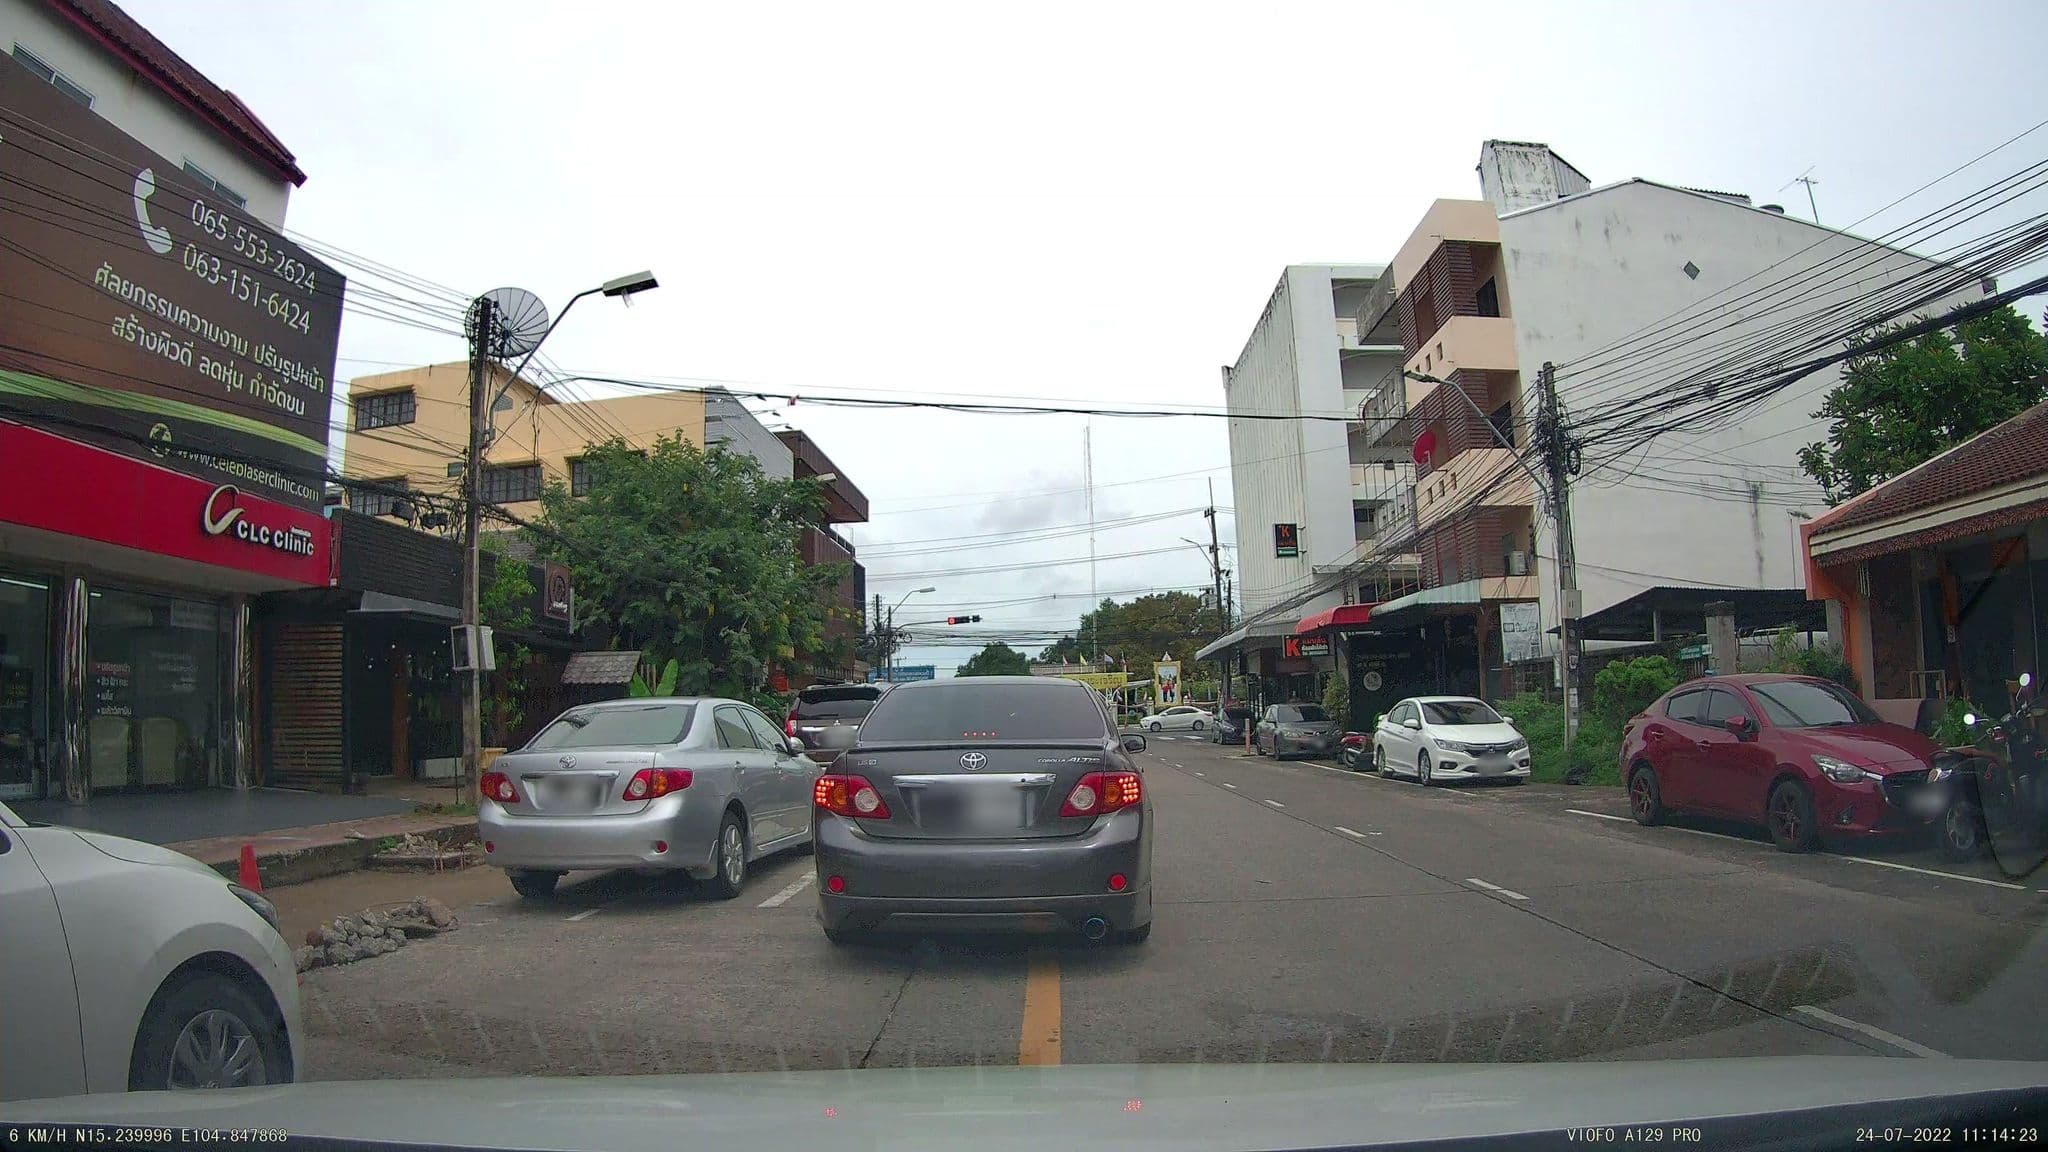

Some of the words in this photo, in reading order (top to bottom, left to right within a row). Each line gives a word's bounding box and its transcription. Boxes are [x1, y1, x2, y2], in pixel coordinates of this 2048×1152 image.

[184, 244, 311, 335] 063-151-6424
[192, 199, 317, 295] 065-553-2624
[95, 261, 249, 357] ศัลยกรรมความงาม
[254, 343, 325, 393] ปรับรูปหน้า
[111, 313, 193, 367] สร้างผิวดี
[199, 356, 243, 392] ลดหุ่น
[250, 372, 305, 416] กำจัดขน
[238, 519, 270, 544] CLC
[274, 528, 314, 556] Clinic
[1286, 638, 1301, 657] K
